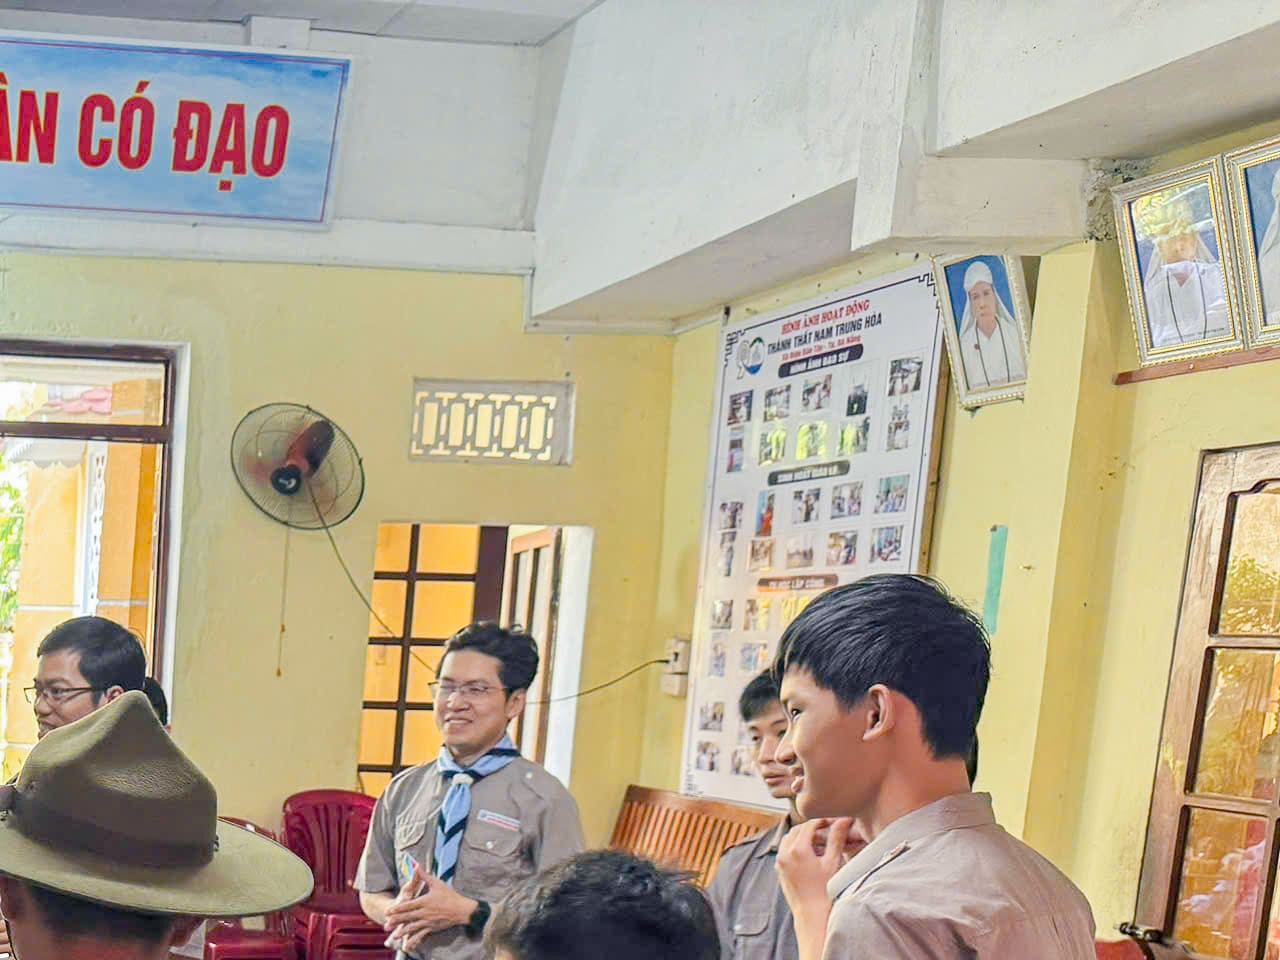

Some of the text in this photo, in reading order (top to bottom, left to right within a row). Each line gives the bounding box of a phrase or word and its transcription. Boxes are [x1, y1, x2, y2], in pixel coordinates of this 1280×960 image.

[78, 81, 155, 170] CÓ
[170, 100, 290, 190] ĐẠO
[814, 326, 833, 343] NAM
[835, 318, 862, 334] TRUNG
